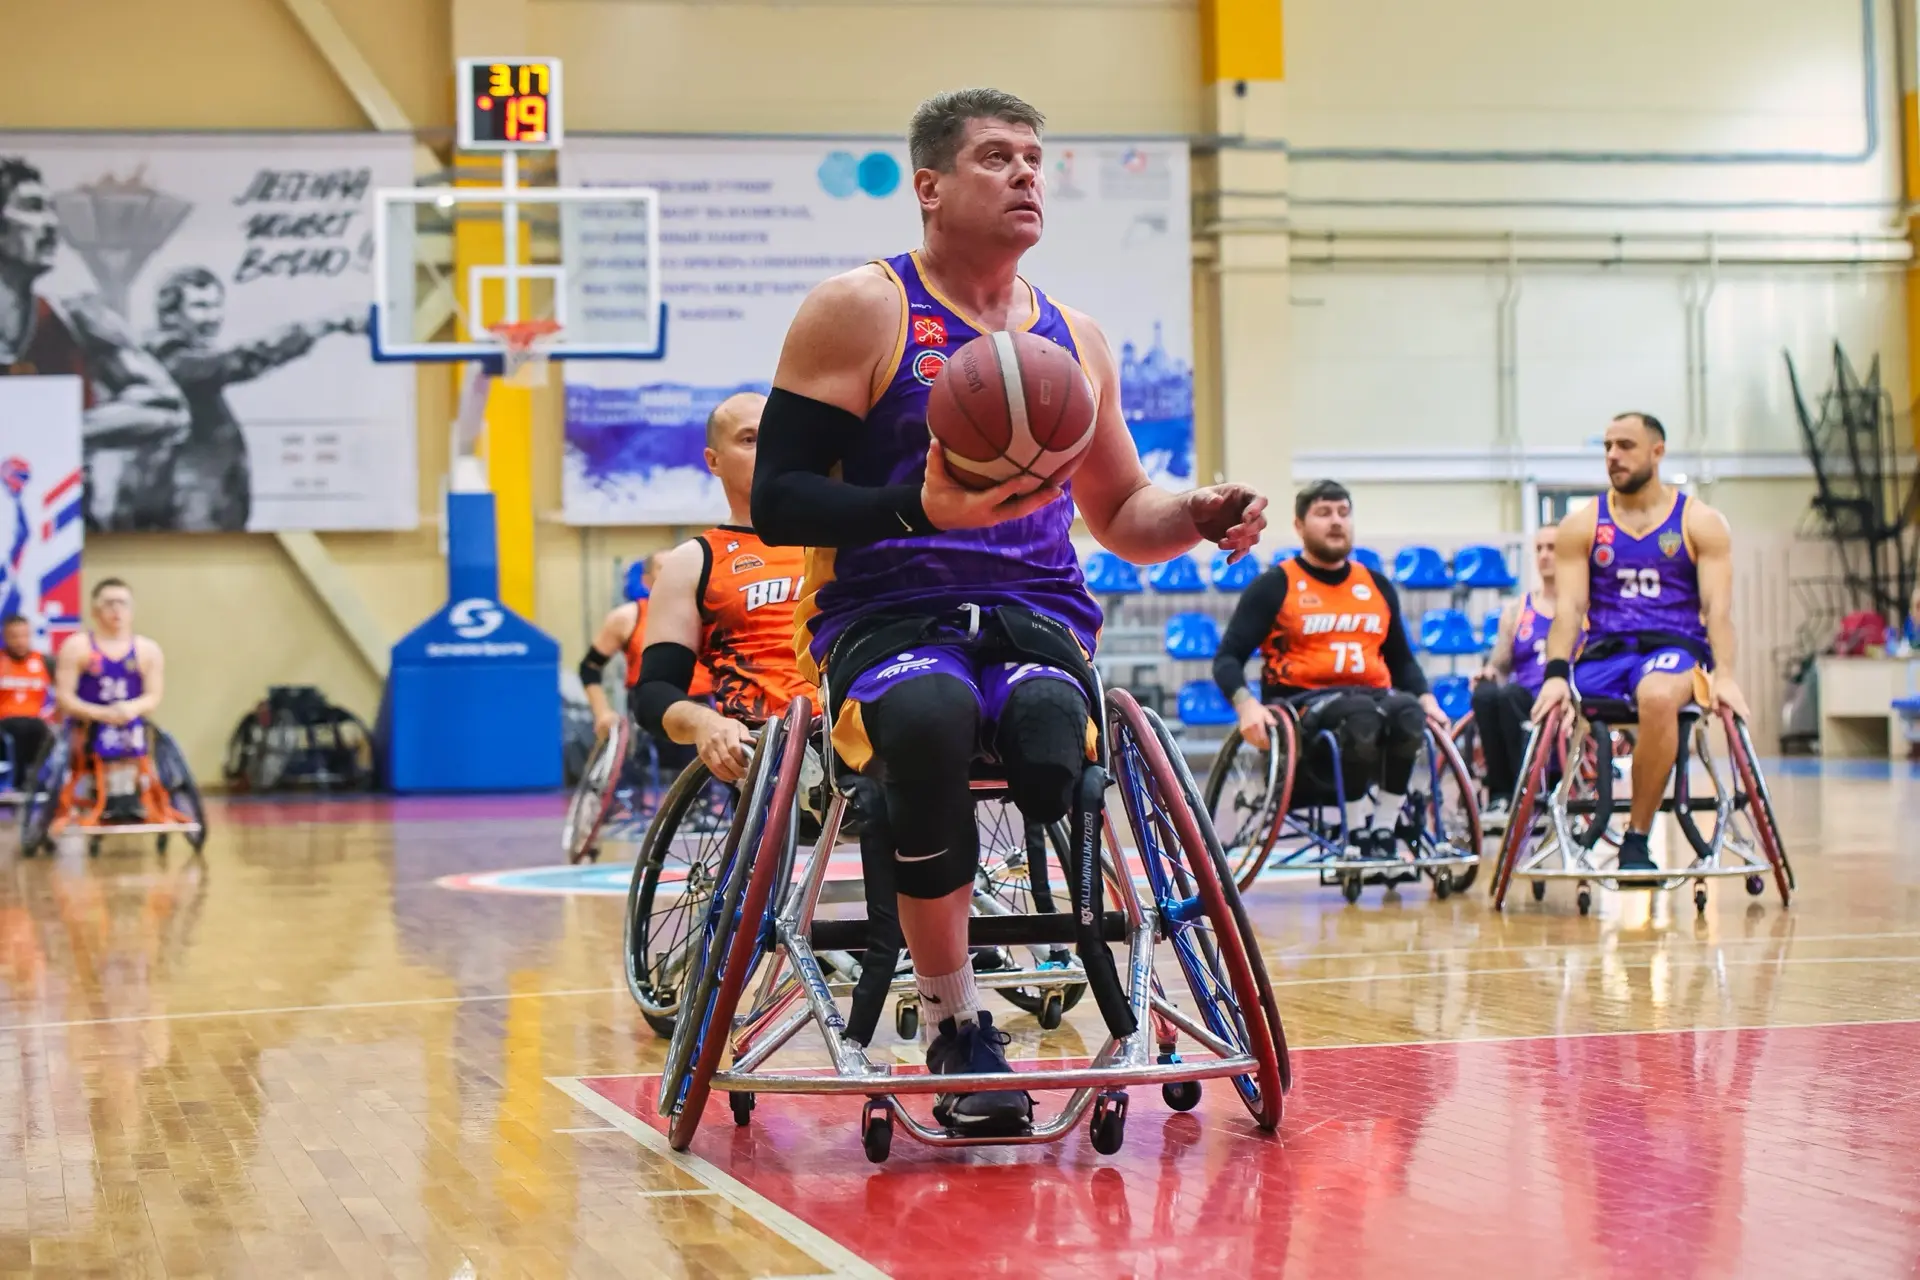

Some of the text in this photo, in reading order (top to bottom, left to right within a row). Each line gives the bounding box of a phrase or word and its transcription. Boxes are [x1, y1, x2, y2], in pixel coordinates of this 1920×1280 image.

[505, 96, 547, 141] 19
[1616, 568, 1661, 599] 30
[1329, 641, 1366, 674] 73
